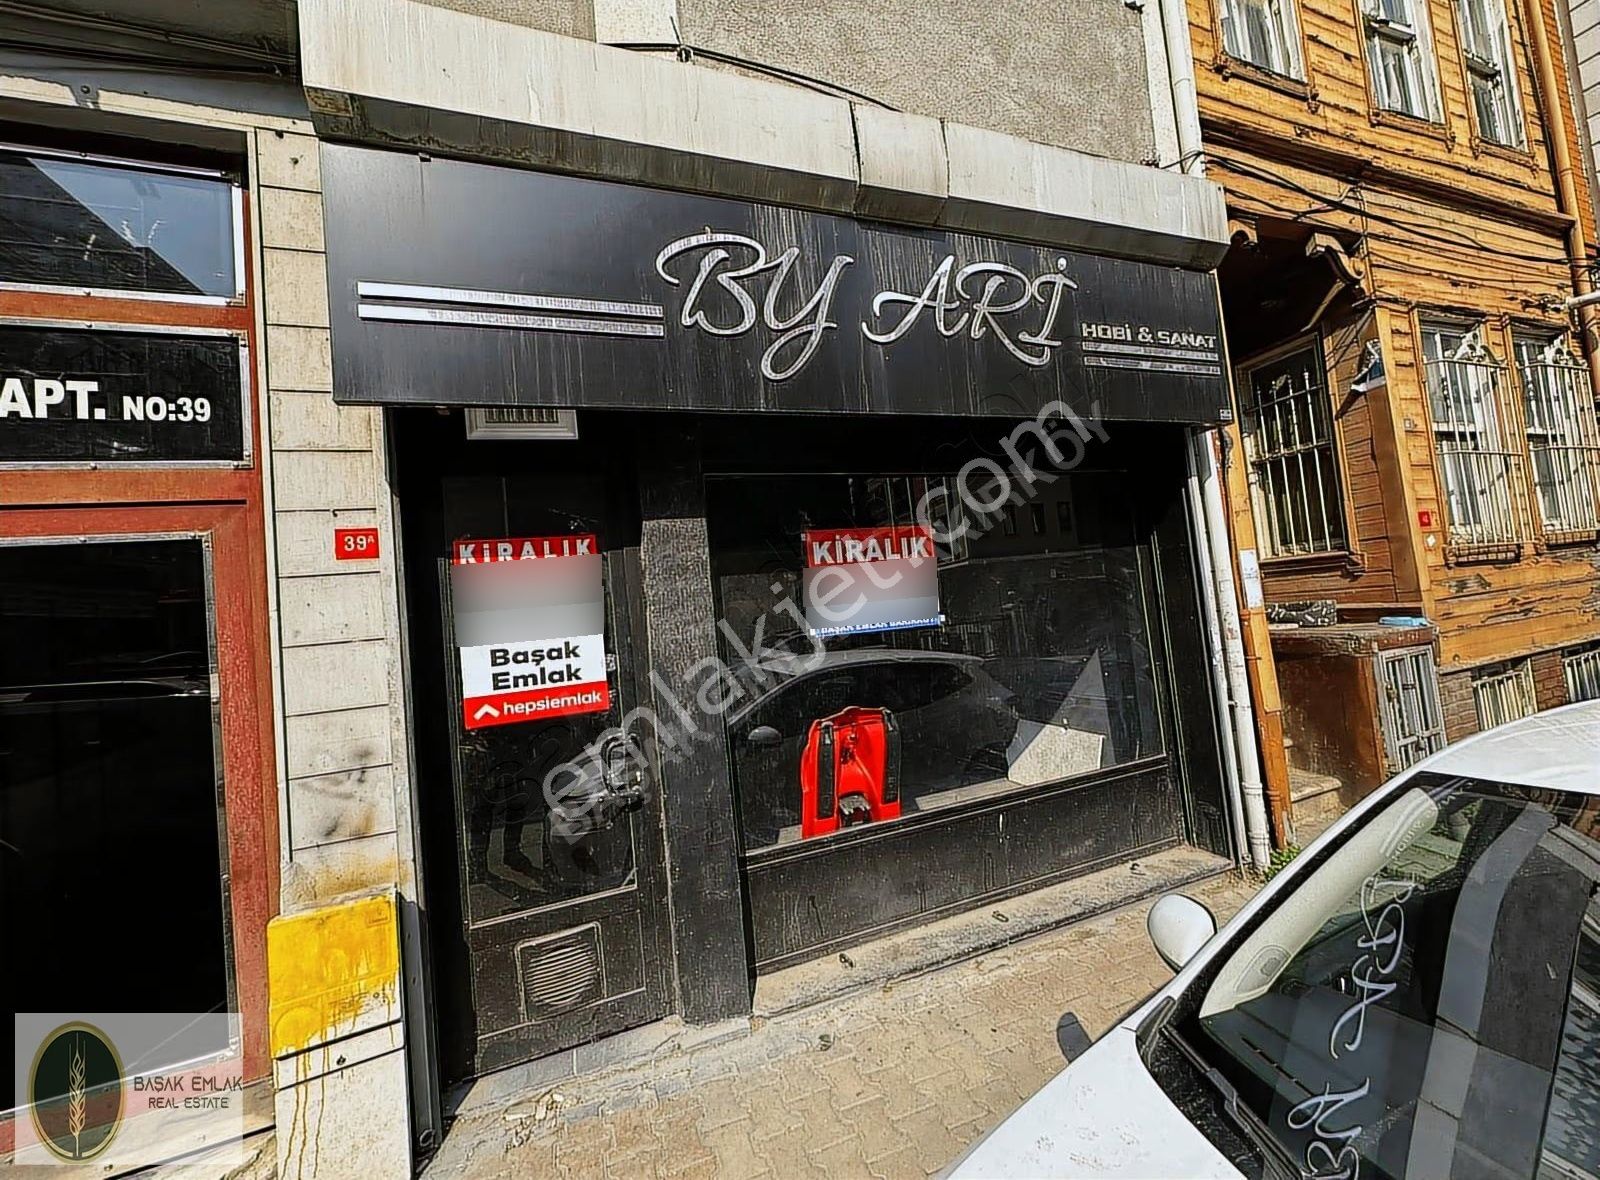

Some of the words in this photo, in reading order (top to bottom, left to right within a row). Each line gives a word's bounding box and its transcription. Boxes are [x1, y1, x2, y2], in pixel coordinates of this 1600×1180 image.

[655, 231, 855, 381] BY
[861, 255, 1079, 366] ARİ
[1137, 326, 1154, 343] &
[1157, 330, 1217, 349] SANAT
[0, 378, 106, 421] APT.
[123, 395, 212, 423] NO:39
[812, 535, 930, 565] KİRALIK
[490, 641, 581, 668] Başak
[491, 664, 583, 691] Emlak
[503, 690, 603, 716] hepsiemlak
